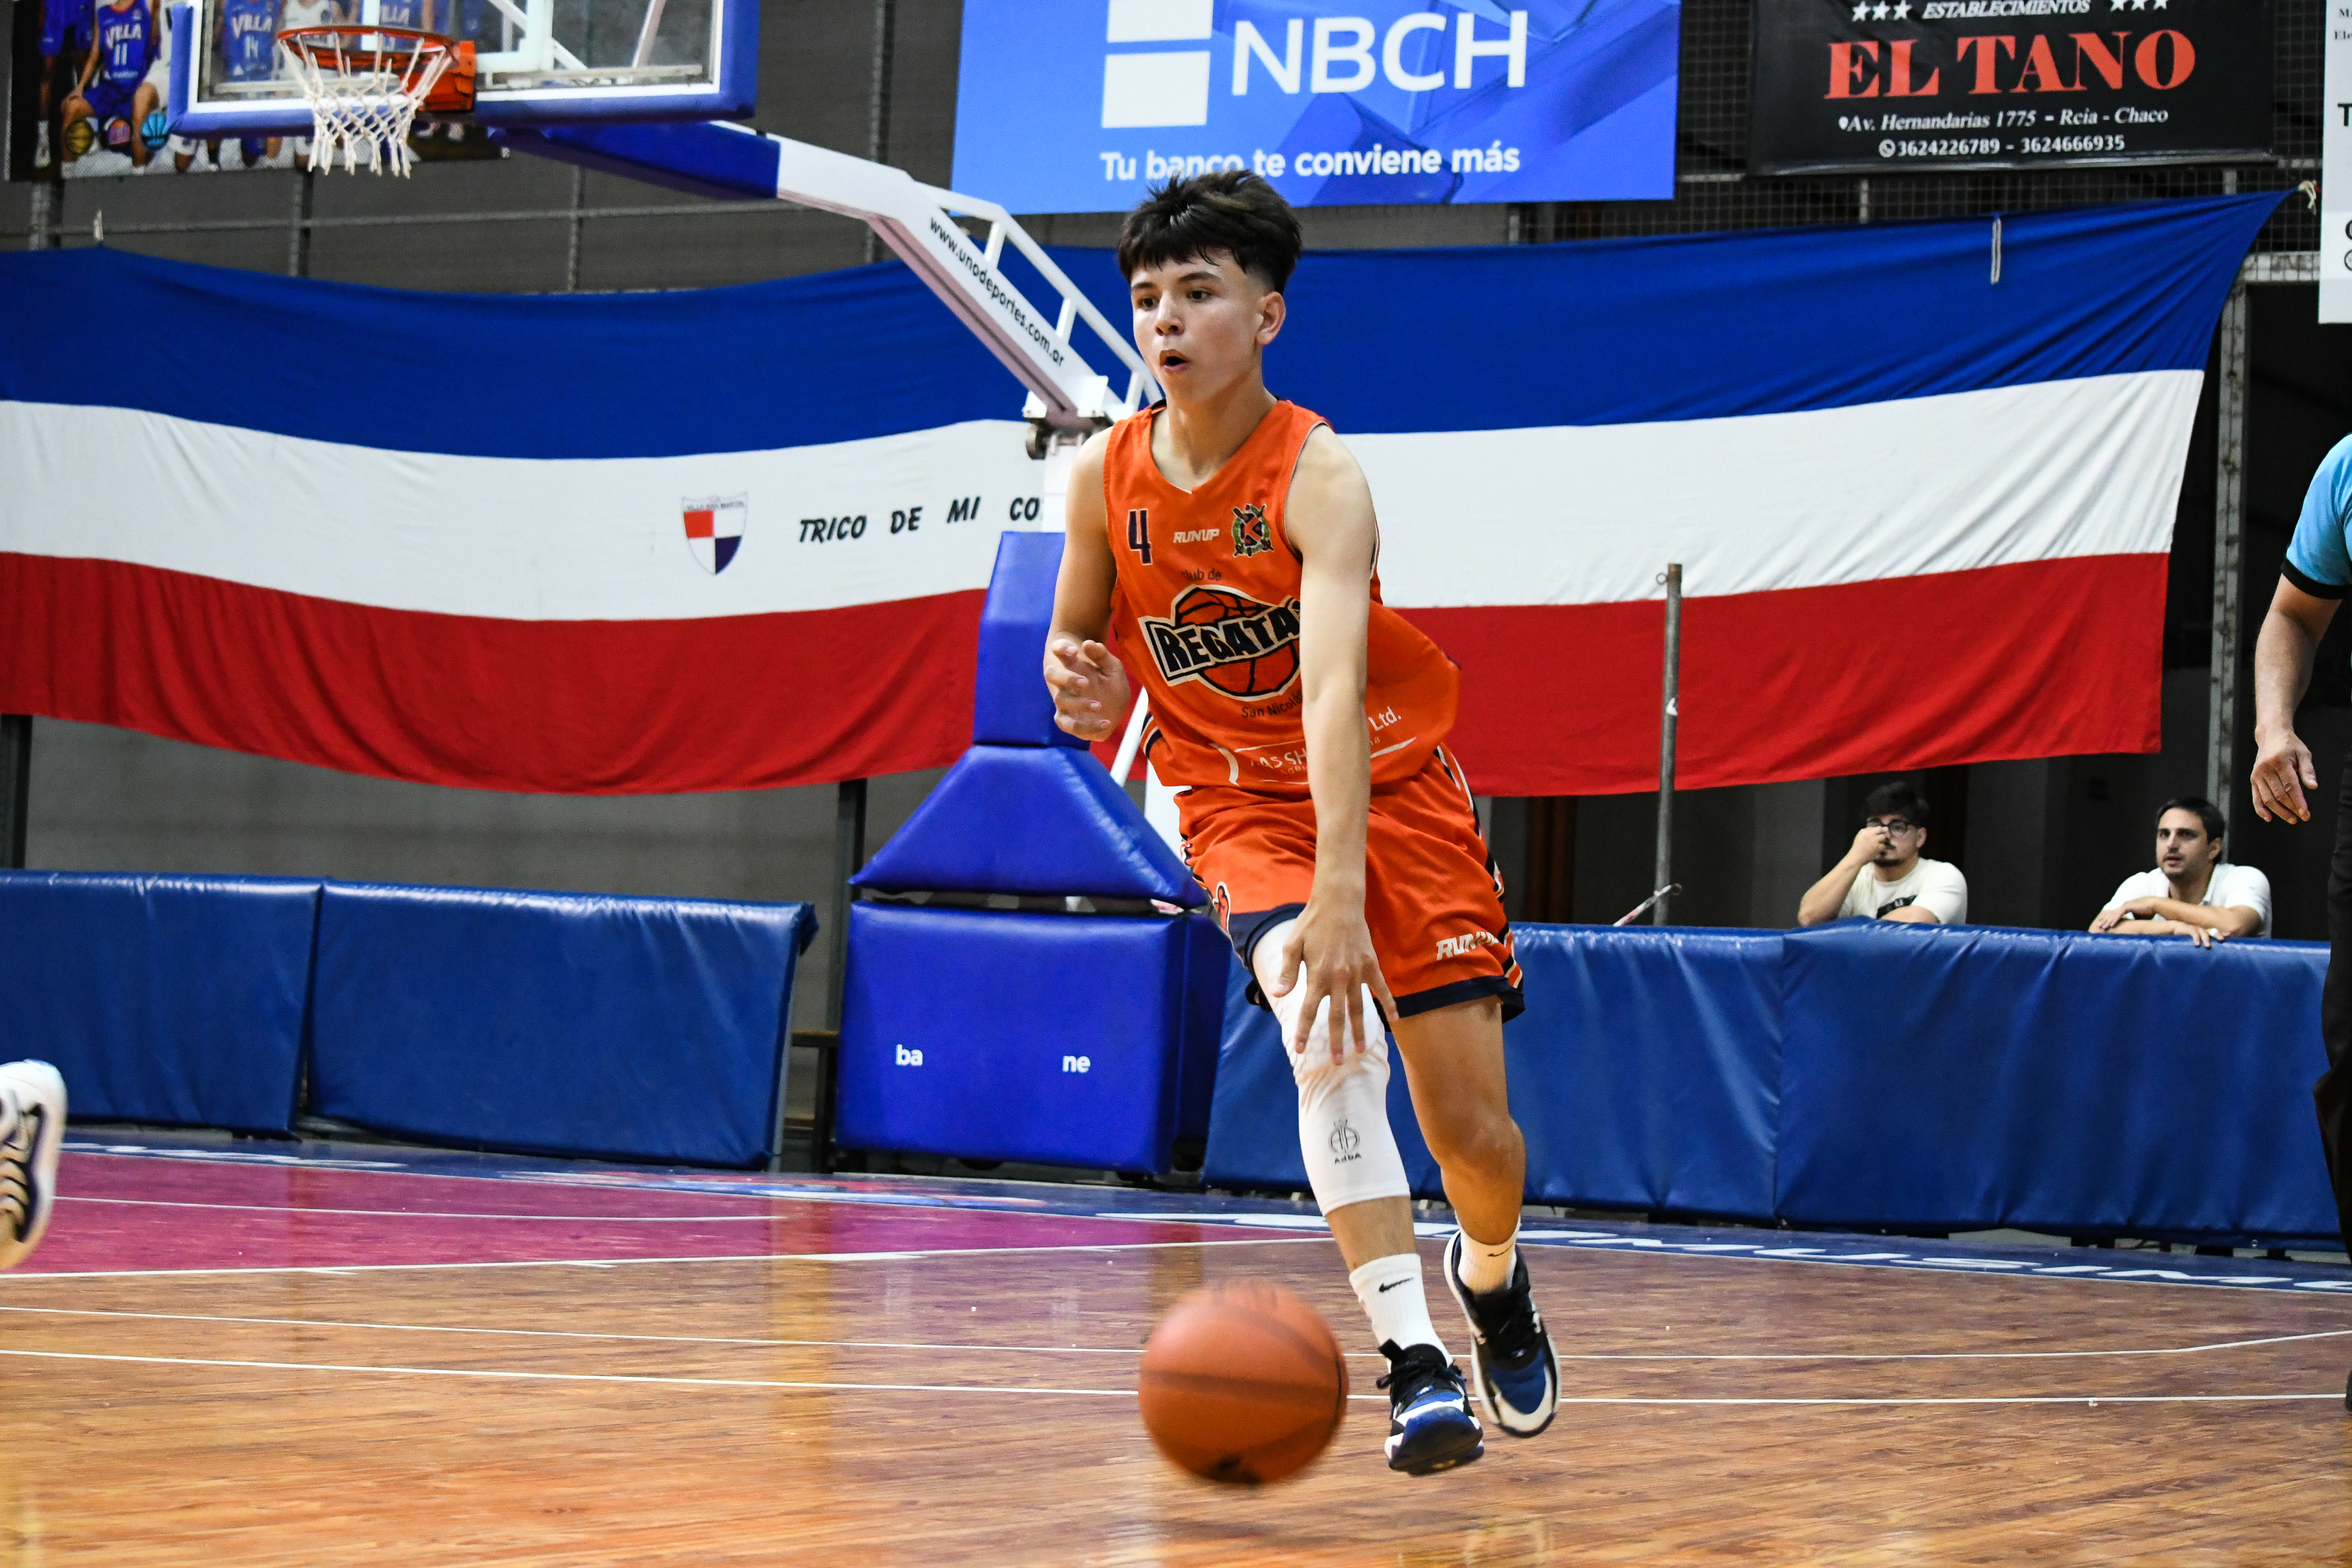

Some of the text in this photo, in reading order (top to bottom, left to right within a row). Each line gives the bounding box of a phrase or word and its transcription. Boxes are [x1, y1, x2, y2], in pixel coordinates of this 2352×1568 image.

[1921, 0, 2091, 20] ESTABLECIMIENTOS
[1232, 11, 1528, 95] NBCH
[1824, 29, 2196, 99] EL TANO
[1847, 114, 1876, 132] Av.
[1880, 111, 1991, 131] Hernandarias
[1996, 110, 2037, 128] 1775
[2059, 107, 2099, 126] Rcia
[2114, 106, 2170, 124] Chaco
[1897, 138, 2001, 157] 3624226789
[2020, 133, 2126, 154] 3624666935
[1100, 140, 1521, 181] Tu banco te conviene más
[930, 217, 1065, 367] www.unodeportes.com.ar
[799, 496, 1040, 544] TRICO DE MI CO
[1127, 508, 1152, 566] 4
[1173, 527, 1220, 544] RUNUP
[1207, 567, 1222, 581] de
[1241, 706, 1265, 719] San
[1368, 705, 1402, 732] Ltd.
[896, 1044, 1092, 1073] ba ne
